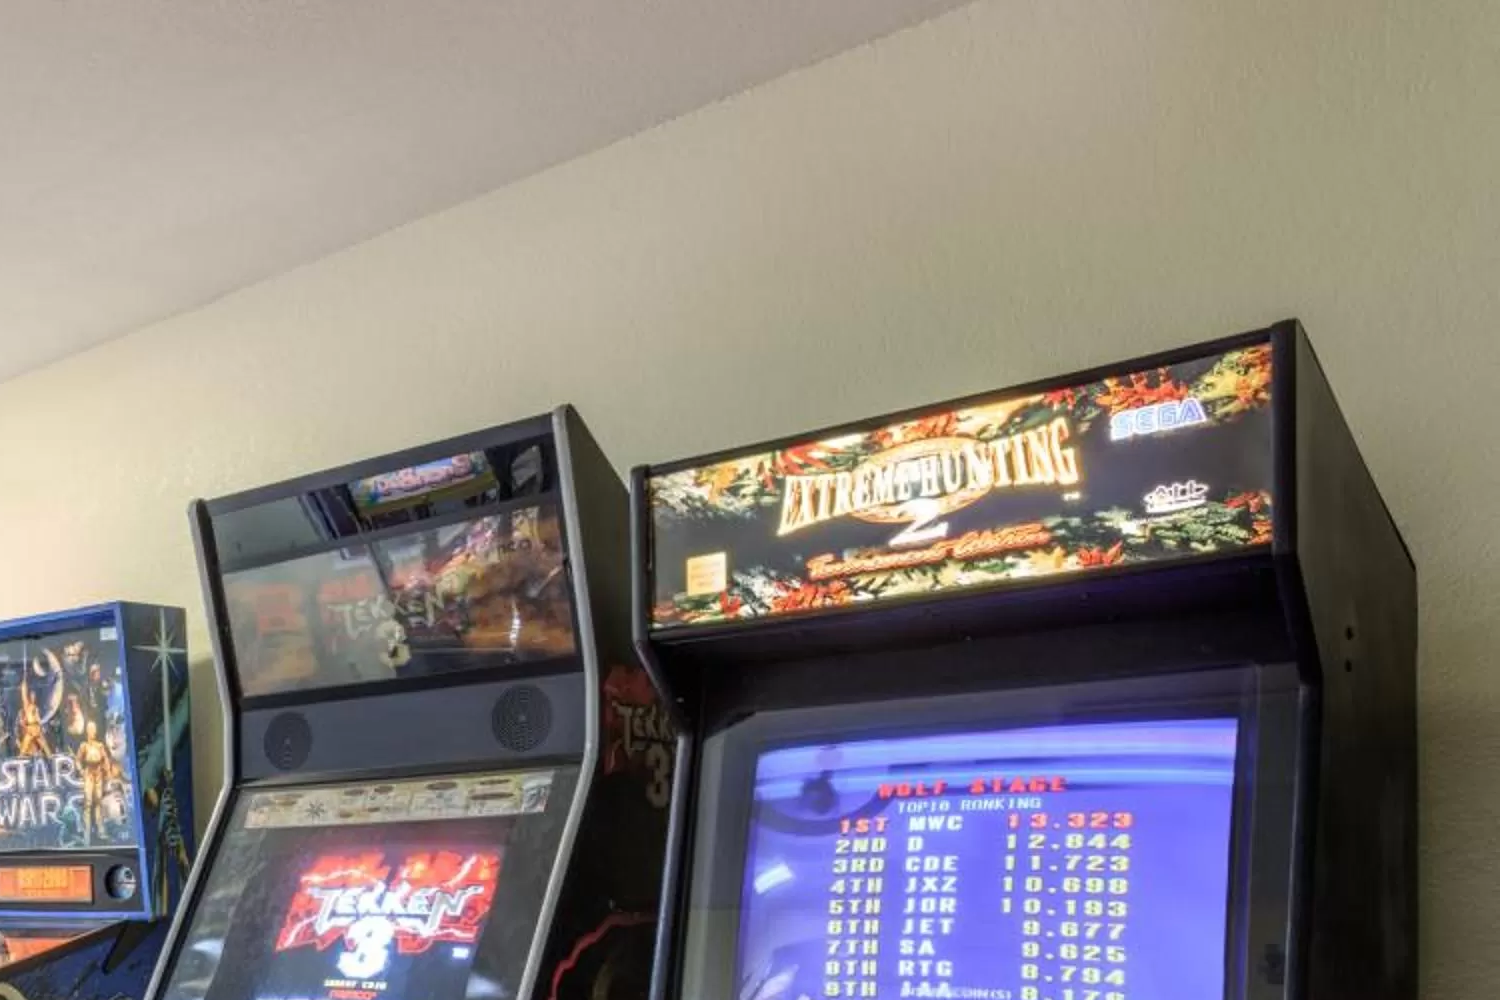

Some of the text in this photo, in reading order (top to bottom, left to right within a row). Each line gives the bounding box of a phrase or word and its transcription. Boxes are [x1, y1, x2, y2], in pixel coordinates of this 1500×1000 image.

[1110, 398, 1207, 441] SEGA
[776, 459, 912, 537] EXTREME
[918, 417, 1080, 498] HUNTING
[888, 497, 950, 548] 2
[611, 699, 677, 760] TEKK
[877, 775, 1067, 799] WOLF STAGE
[960, 797, 1042, 811] RANKING
[839, 816, 889, 833] 1ST
[908, 815, 964, 832] MWC
[835, 837, 888, 854] 2ND
[907, 836, 925, 851] D
[832, 857, 886, 873] 3RD
[905, 855, 960, 873] CDE
[829, 877, 884, 894] 4TH
[904, 876, 958, 893] JXZ
[308, 880, 484, 938] TEKKEN
[828, 898, 882, 914] 5TH
[902, 918, 955, 935] JET
[337, 917, 393, 978] 3
[826, 939, 879, 956] 7TH
[900, 938, 936, 956] SA
[898, 959, 953, 977] RTG
